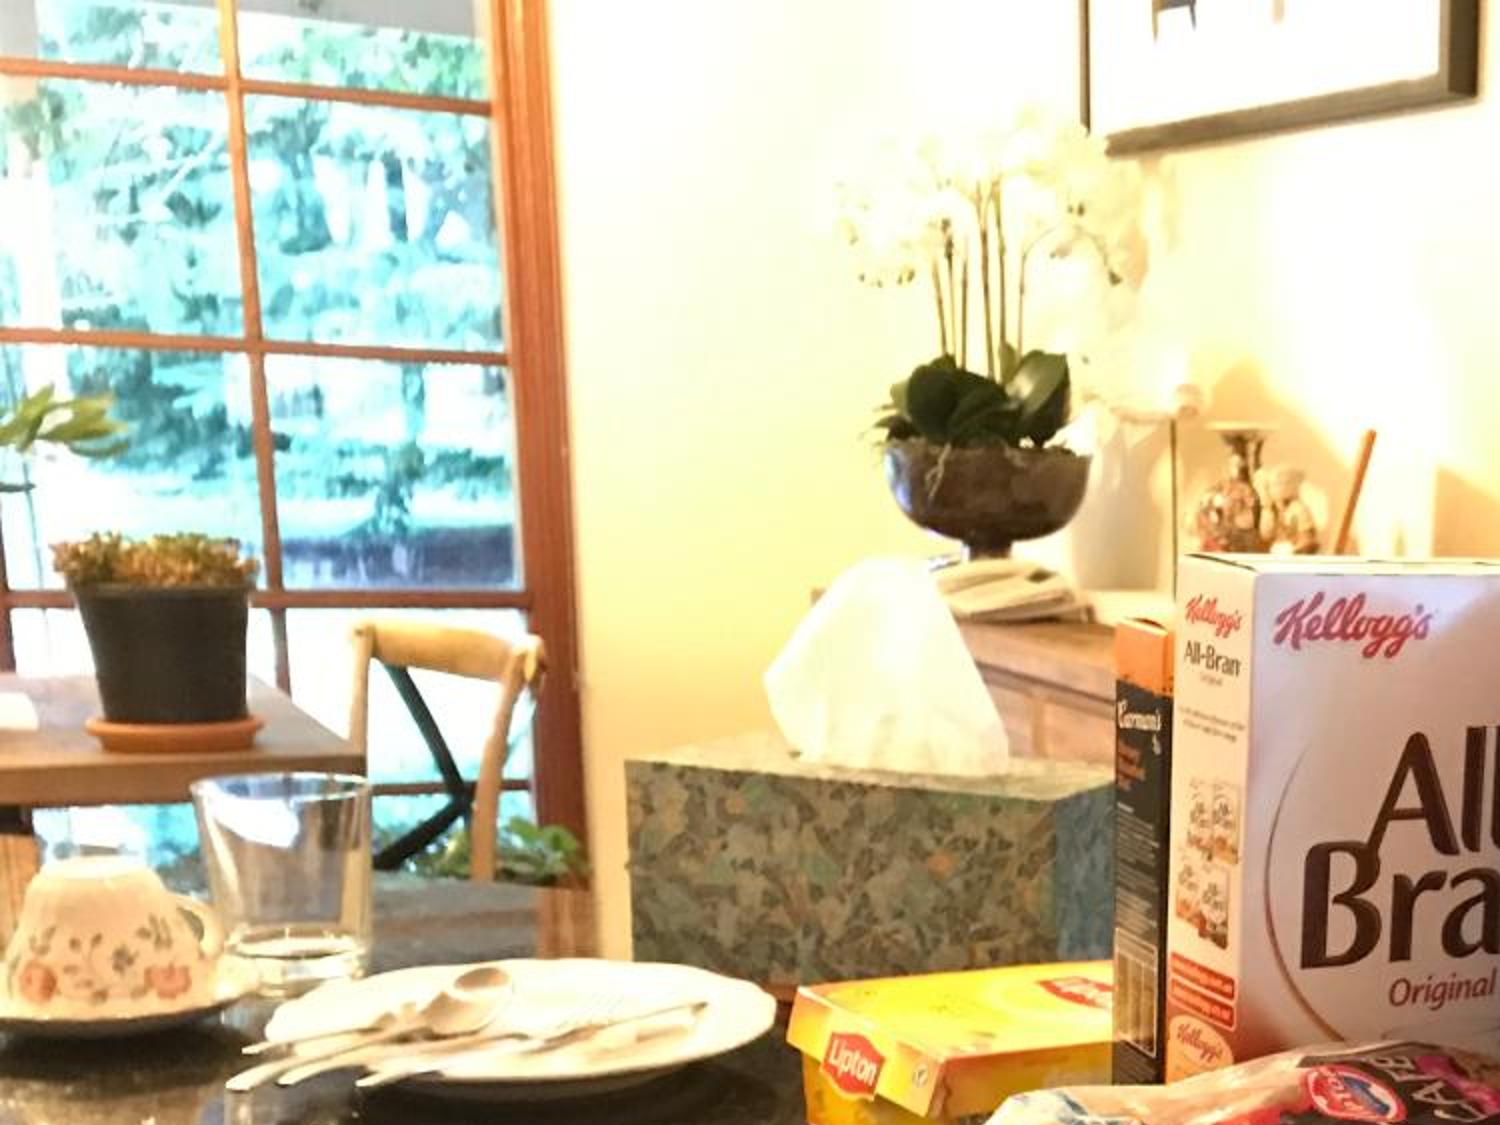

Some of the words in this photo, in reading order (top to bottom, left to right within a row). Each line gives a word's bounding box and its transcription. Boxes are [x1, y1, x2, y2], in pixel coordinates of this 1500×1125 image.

[1185, 593, 1242, 638] Kellogg's
[1273, 591, 1434, 659] Kellogg's
[1184, 640, 1241, 677] All-Bran
[1388, 968, 1498, 1012] Original
[829, 1039, 878, 1086] Lipton
